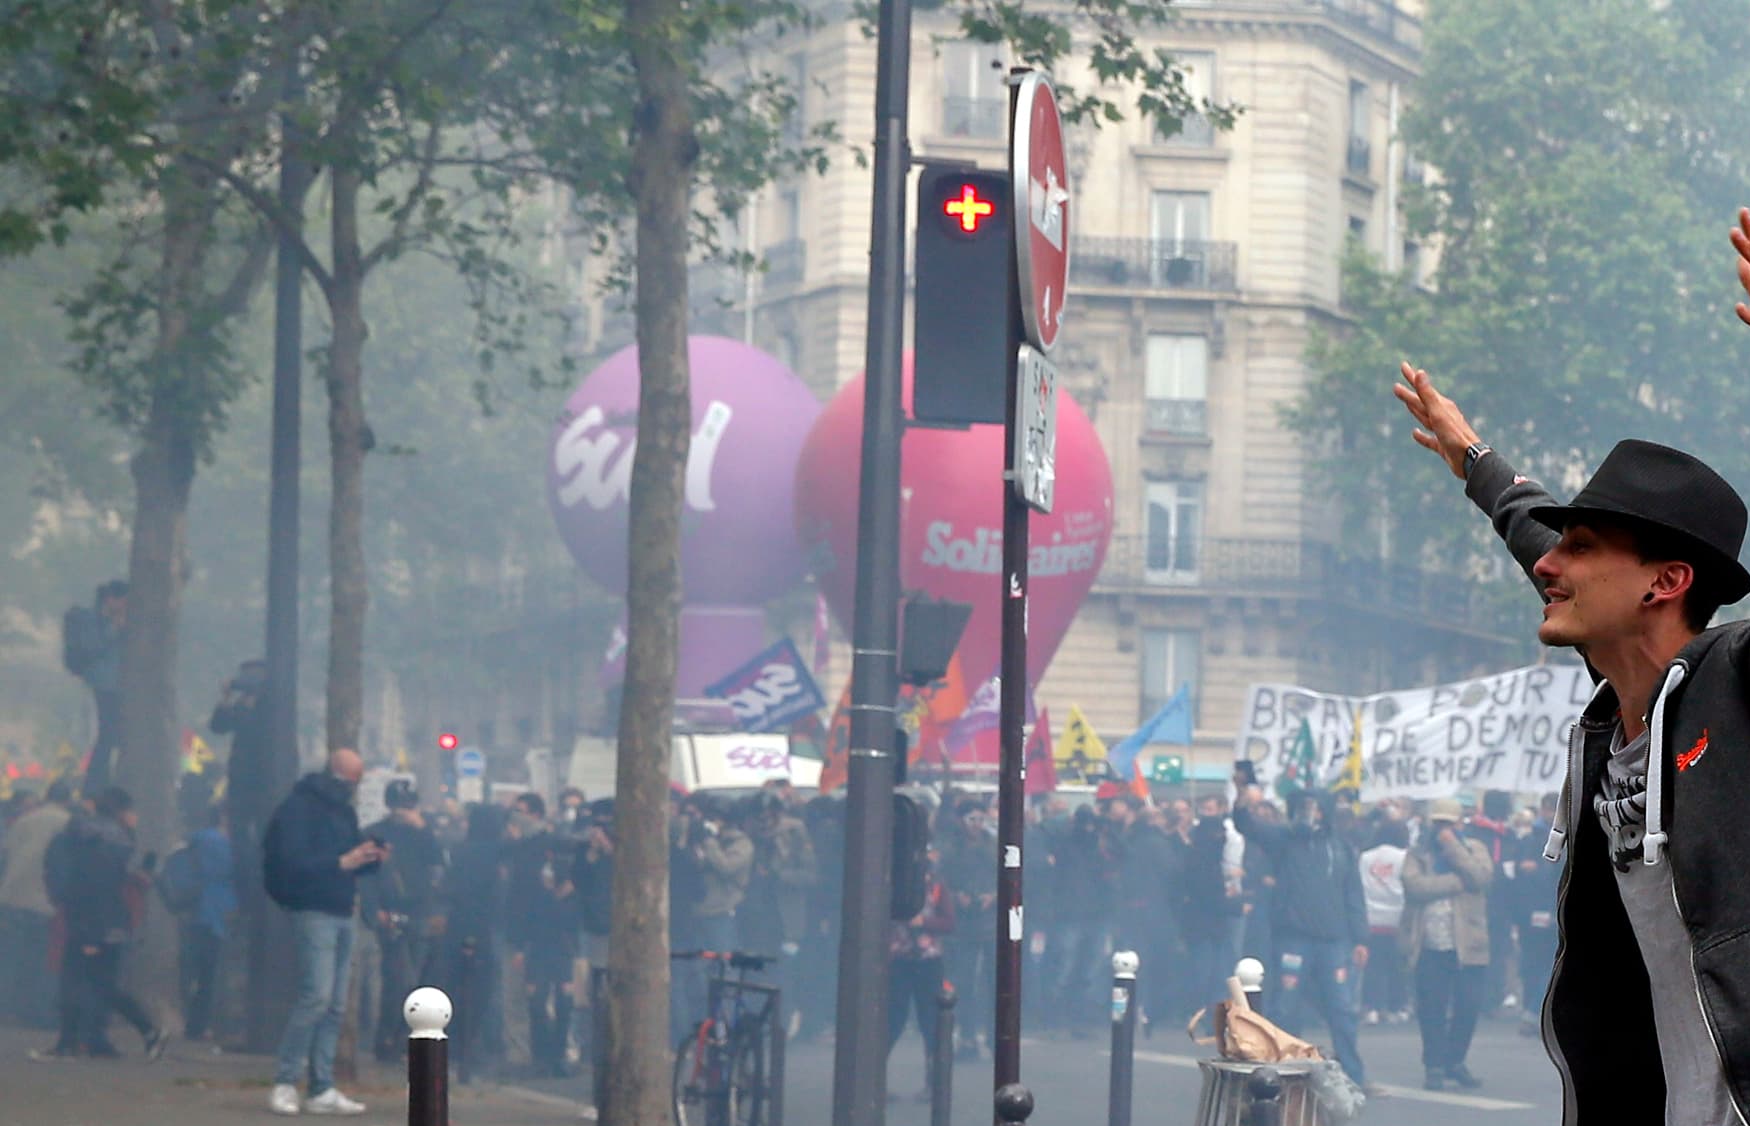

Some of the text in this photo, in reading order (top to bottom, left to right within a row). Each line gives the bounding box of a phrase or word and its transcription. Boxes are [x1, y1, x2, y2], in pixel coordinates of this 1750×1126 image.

[922, 519, 1097, 577] Soliaires
[1429, 667, 1555, 717] POUR
[1447, 705, 1574, 750] DÉMOC
